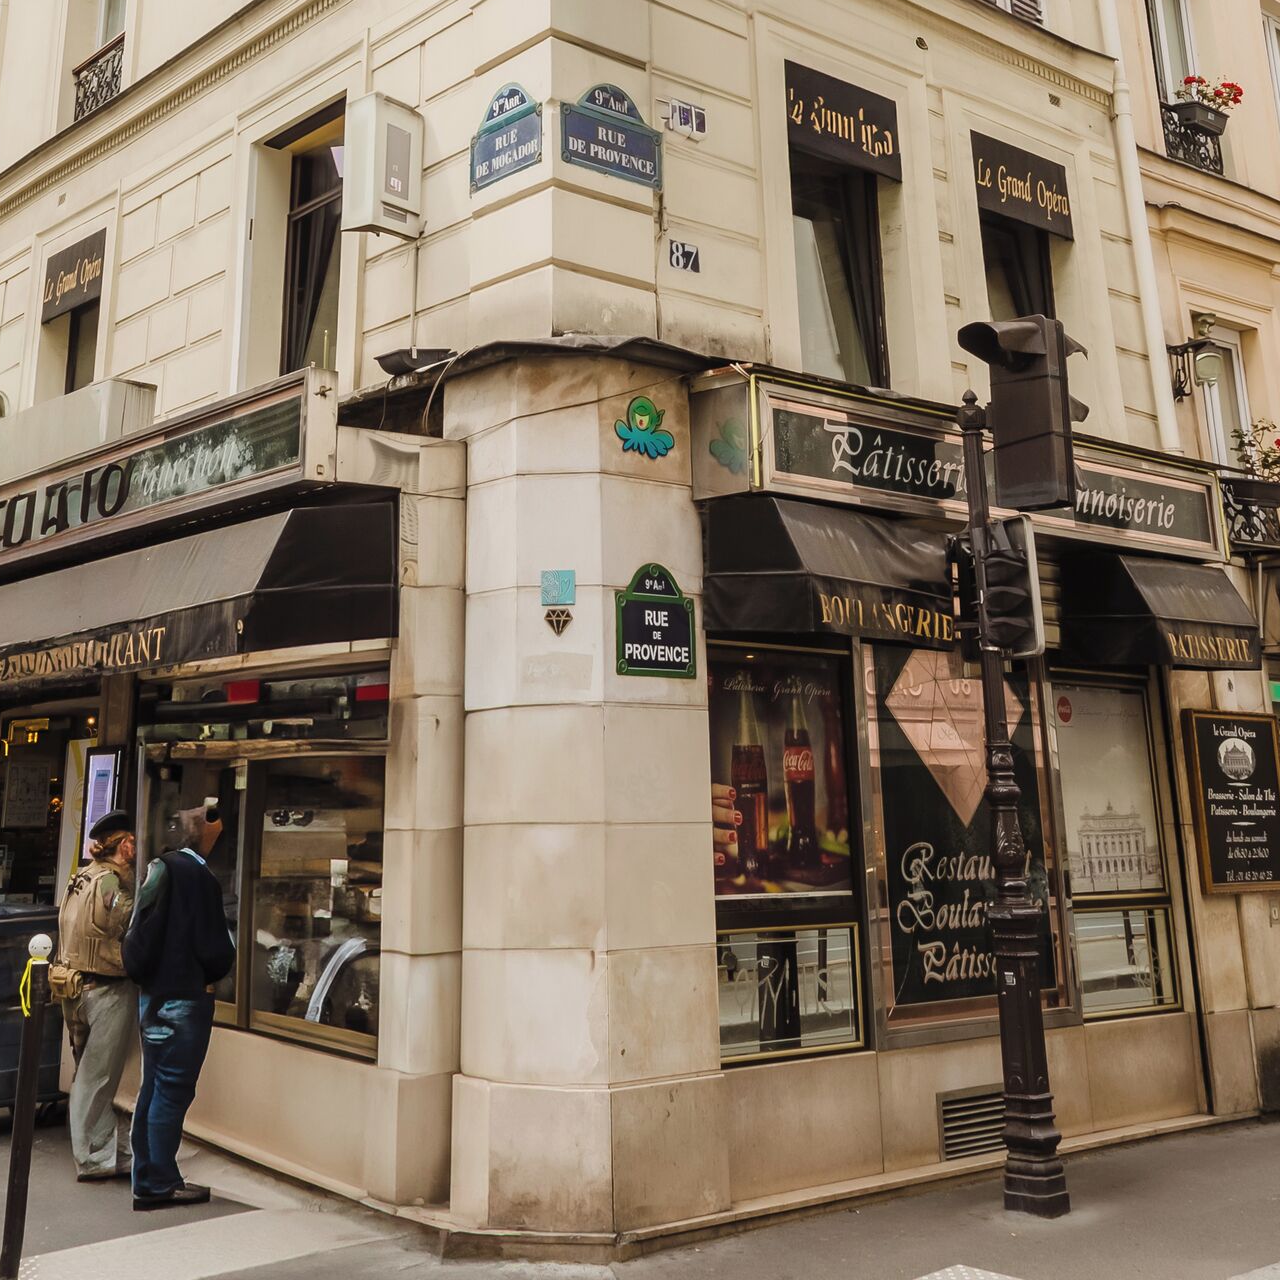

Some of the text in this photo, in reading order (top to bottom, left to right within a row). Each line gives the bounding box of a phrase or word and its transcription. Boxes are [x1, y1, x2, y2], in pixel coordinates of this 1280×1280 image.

[495, 128, 518, 151] RUE
[597, 126, 626, 148] RUE
[475, 139, 538, 179] DE MOGADOR
[568, 136, 655, 176] DE PROVENCE
[977, 158, 1069, 221] Le Grand Opéra
[671, 241, 698, 268] 87
[823, 418, 1176, 529] Pâtisseri nnoiserie
[645, 610, 669, 627] RUE
[653, 631, 662, 640] DE
[624, 643, 690, 663] PROVENCE
[1167, 632, 1253, 663] PATISSERIE
[1207, 788, 1234, 800] Brasserie
[1238, 787, 1255, 801] Salon
[1255, 788, 1263, 801] de
[1242, 803, 1277, 819] Boulangerie
